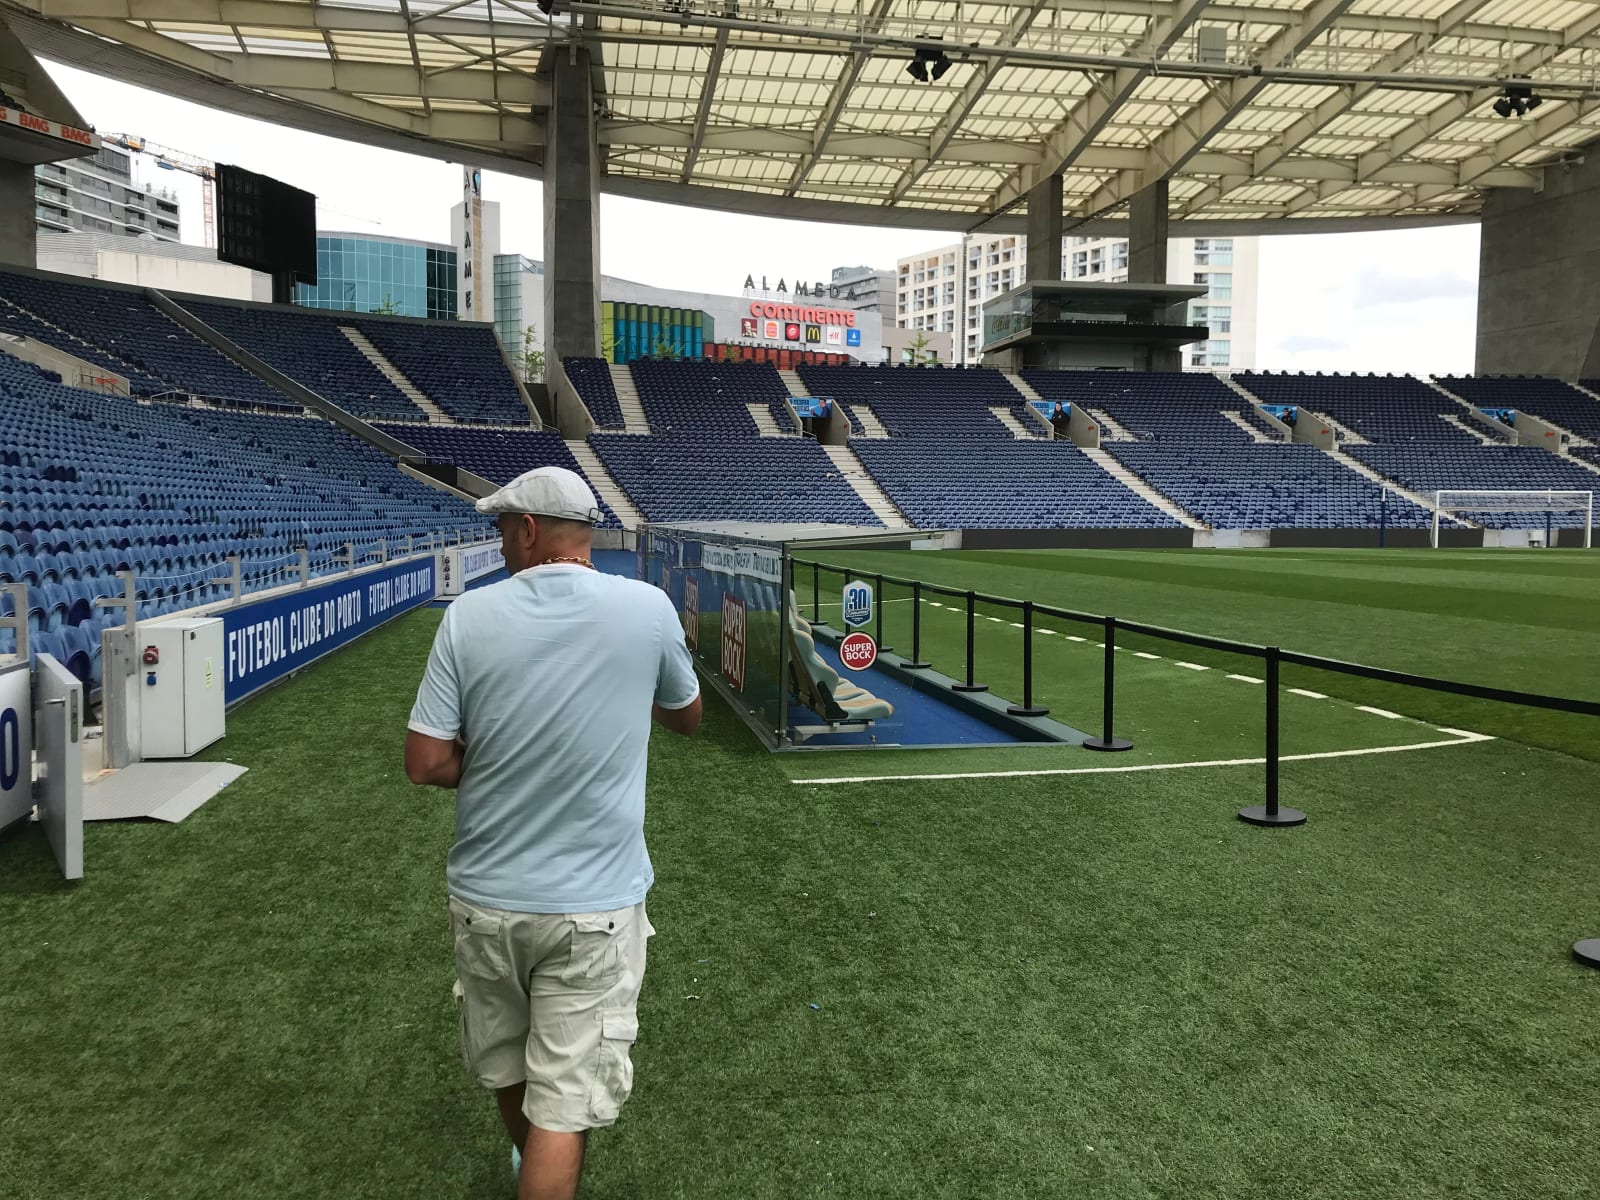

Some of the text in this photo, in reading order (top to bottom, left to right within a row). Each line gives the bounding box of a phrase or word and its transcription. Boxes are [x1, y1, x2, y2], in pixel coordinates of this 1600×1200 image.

[743, 273, 858, 301] ALAMEDA
[749, 301, 856, 327] CONTINENTE
[369, 578, 395, 617] FUTEBOL
[848, 588, 868, 609] 30
[724, 598, 743, 644] SUPER
[228, 589, 361, 683] FUTEBOL CLUBE DO PORTO
[844, 642, 872, 653] SUPER
[724, 635, 741, 685] BOCK
[846, 651, 871, 661] BOCK
